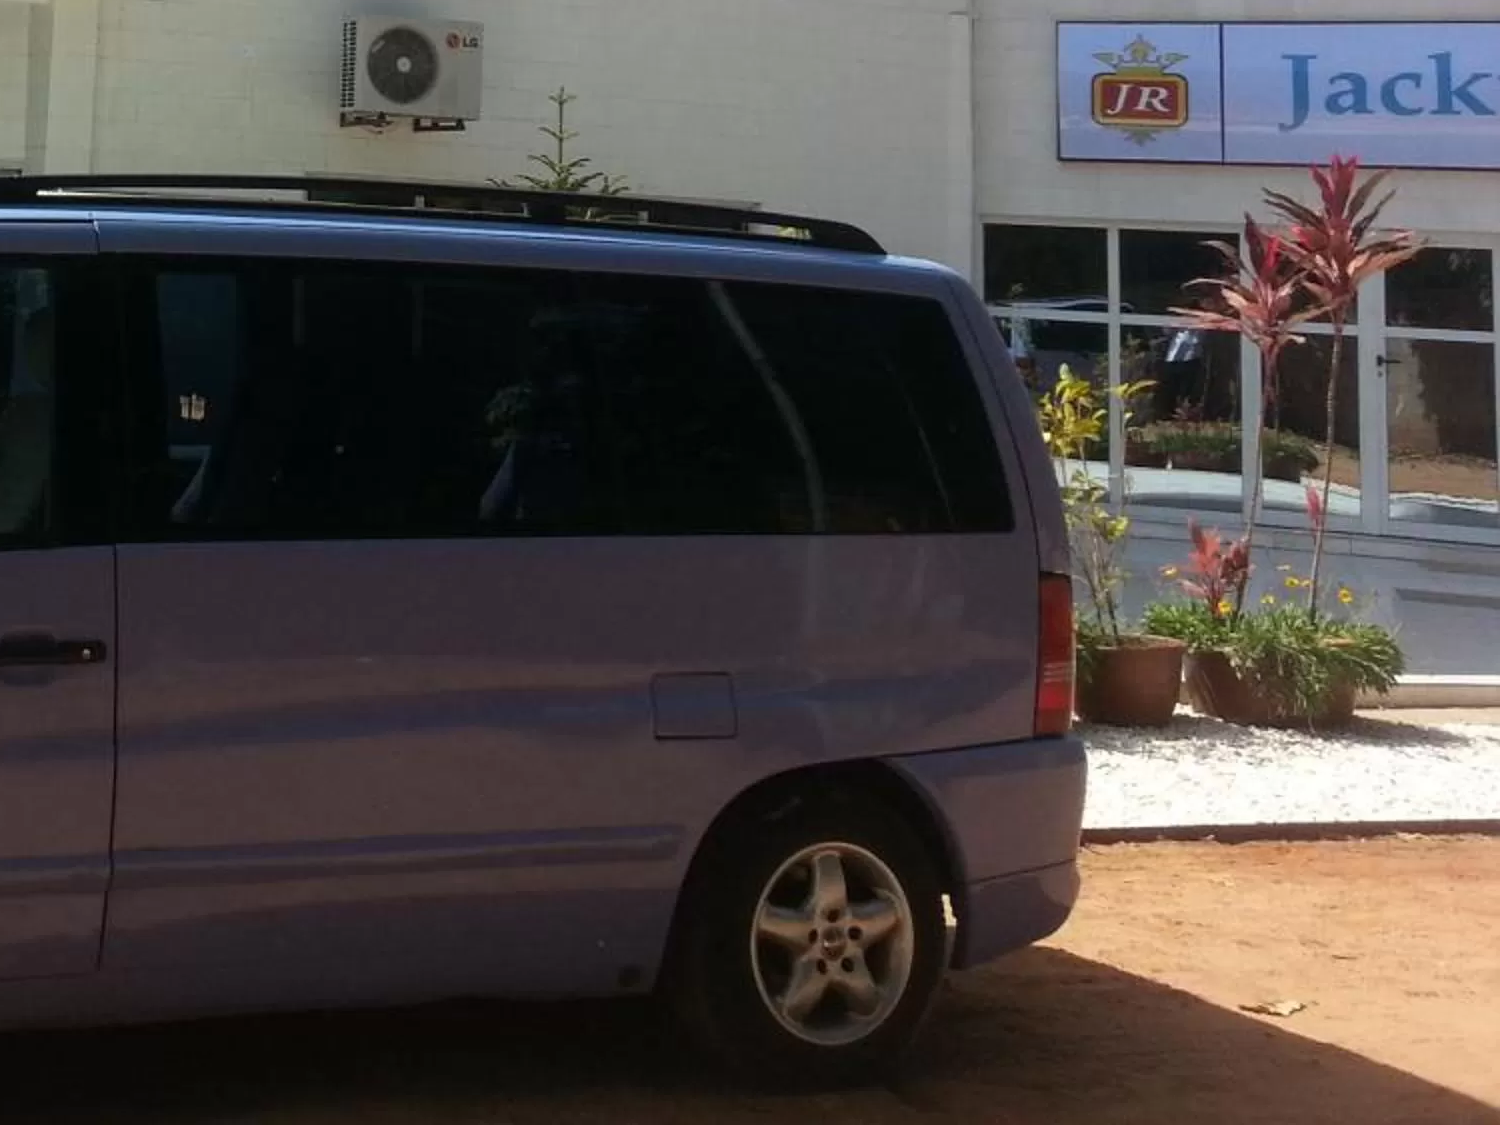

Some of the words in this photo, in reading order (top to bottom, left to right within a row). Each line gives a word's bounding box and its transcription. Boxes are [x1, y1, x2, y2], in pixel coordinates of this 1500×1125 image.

[461, 35, 479, 49] LG
[1107, 83, 1173, 115] JR
[1278, 51, 1500, 132] Jack
